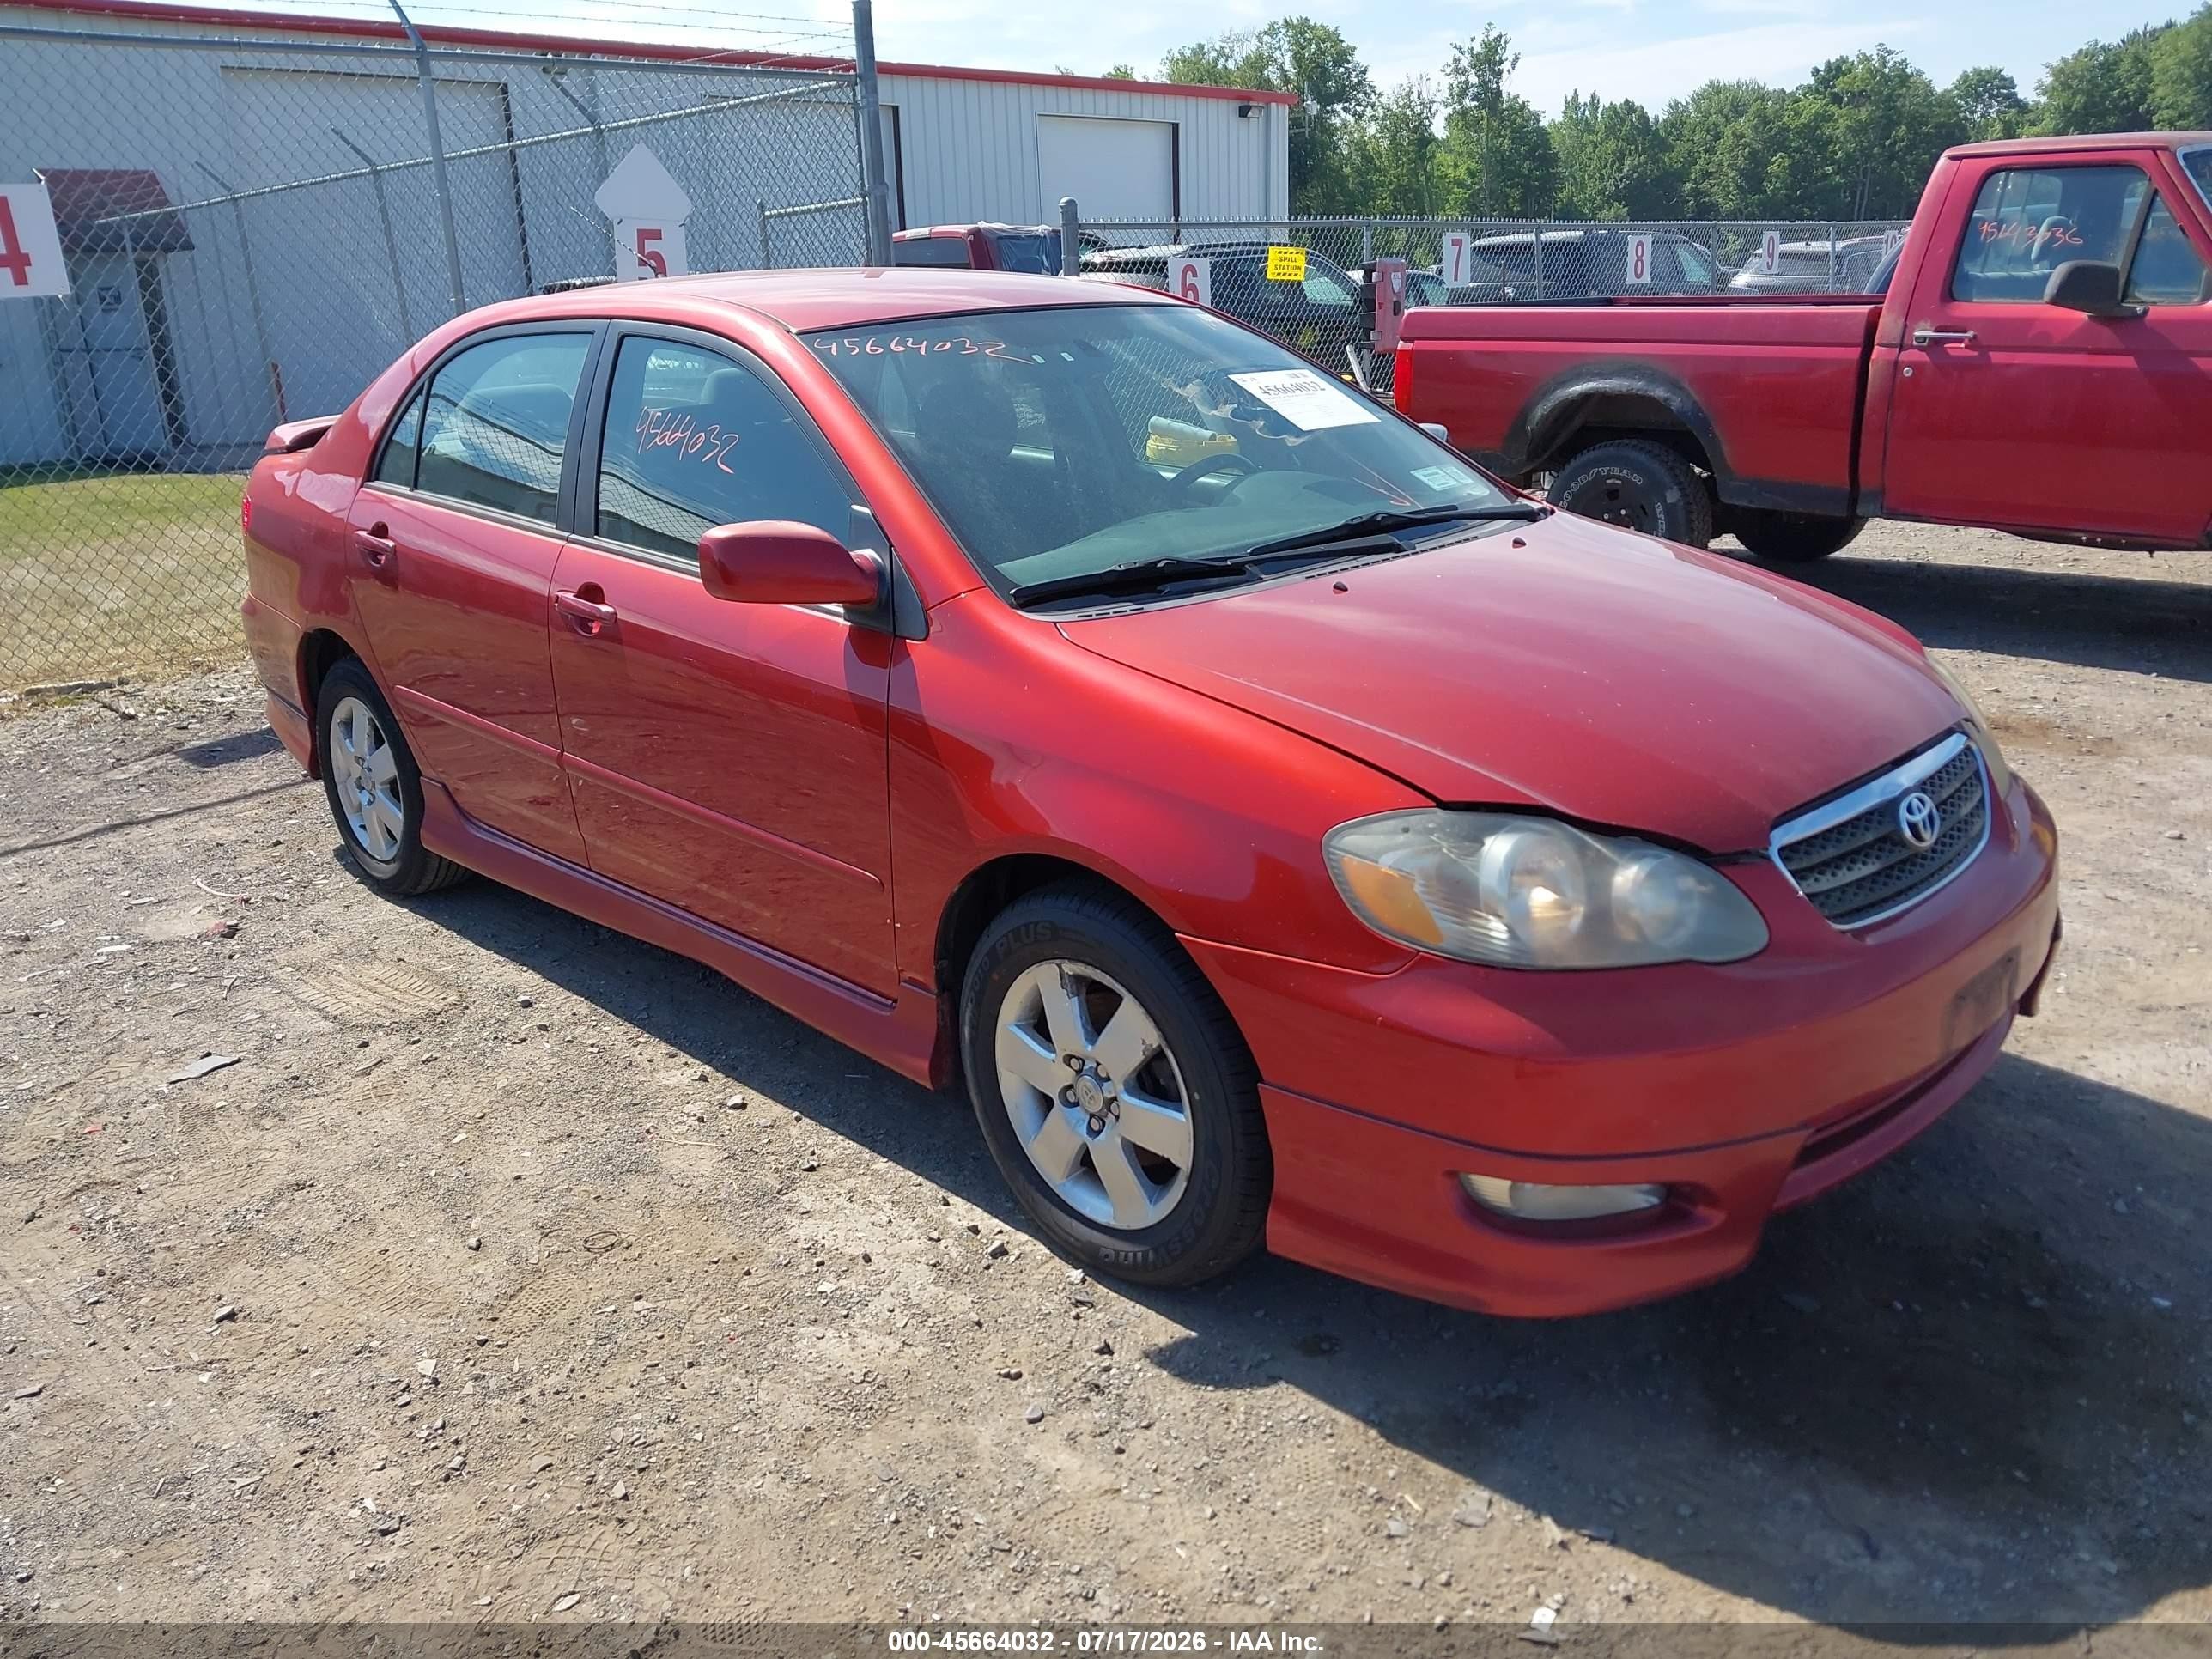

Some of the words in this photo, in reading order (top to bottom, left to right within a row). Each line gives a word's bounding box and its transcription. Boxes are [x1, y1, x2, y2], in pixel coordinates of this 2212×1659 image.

[0, 195, 32, 286] 4
[636, 228, 668, 280] 5
[1450, 238, 1463, 283] 7
[1633, 240, 1645, 280] 8
[1765, 234, 1776, 270] 9
[1181, 264, 1200, 302] 6
[813, 337, 1035, 366] 45664032
[1257, 380, 1327, 397] 45664032
[635, 405, 739, 474] 45664032
